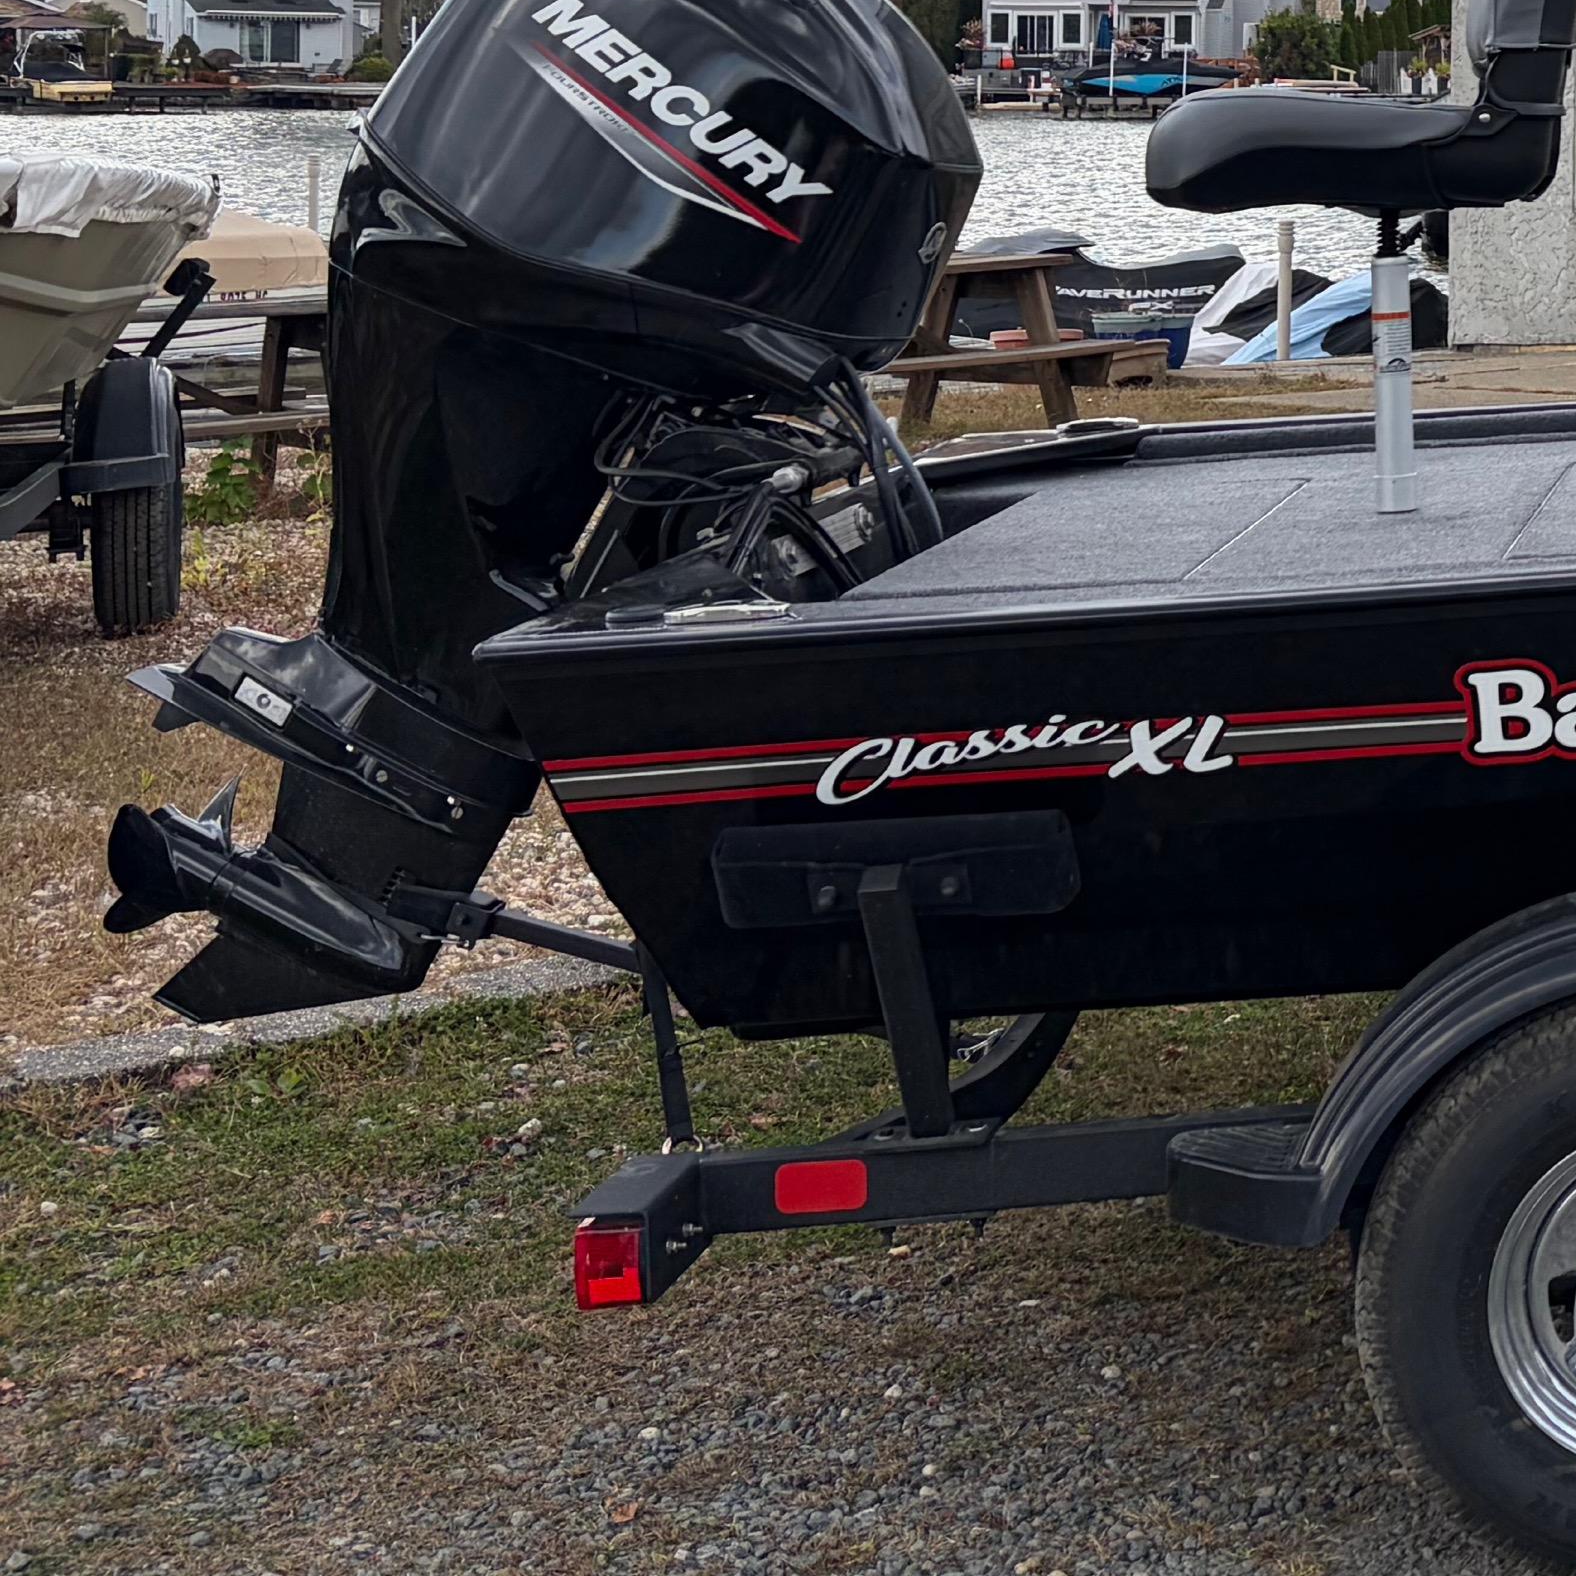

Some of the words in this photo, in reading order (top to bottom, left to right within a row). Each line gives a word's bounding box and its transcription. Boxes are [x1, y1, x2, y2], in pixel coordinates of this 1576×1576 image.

[1056, 284, 1215, 299] AVERUNNER
[816, 714, 1121, 806] Classic
[1108, 714, 1234, 779] XL
